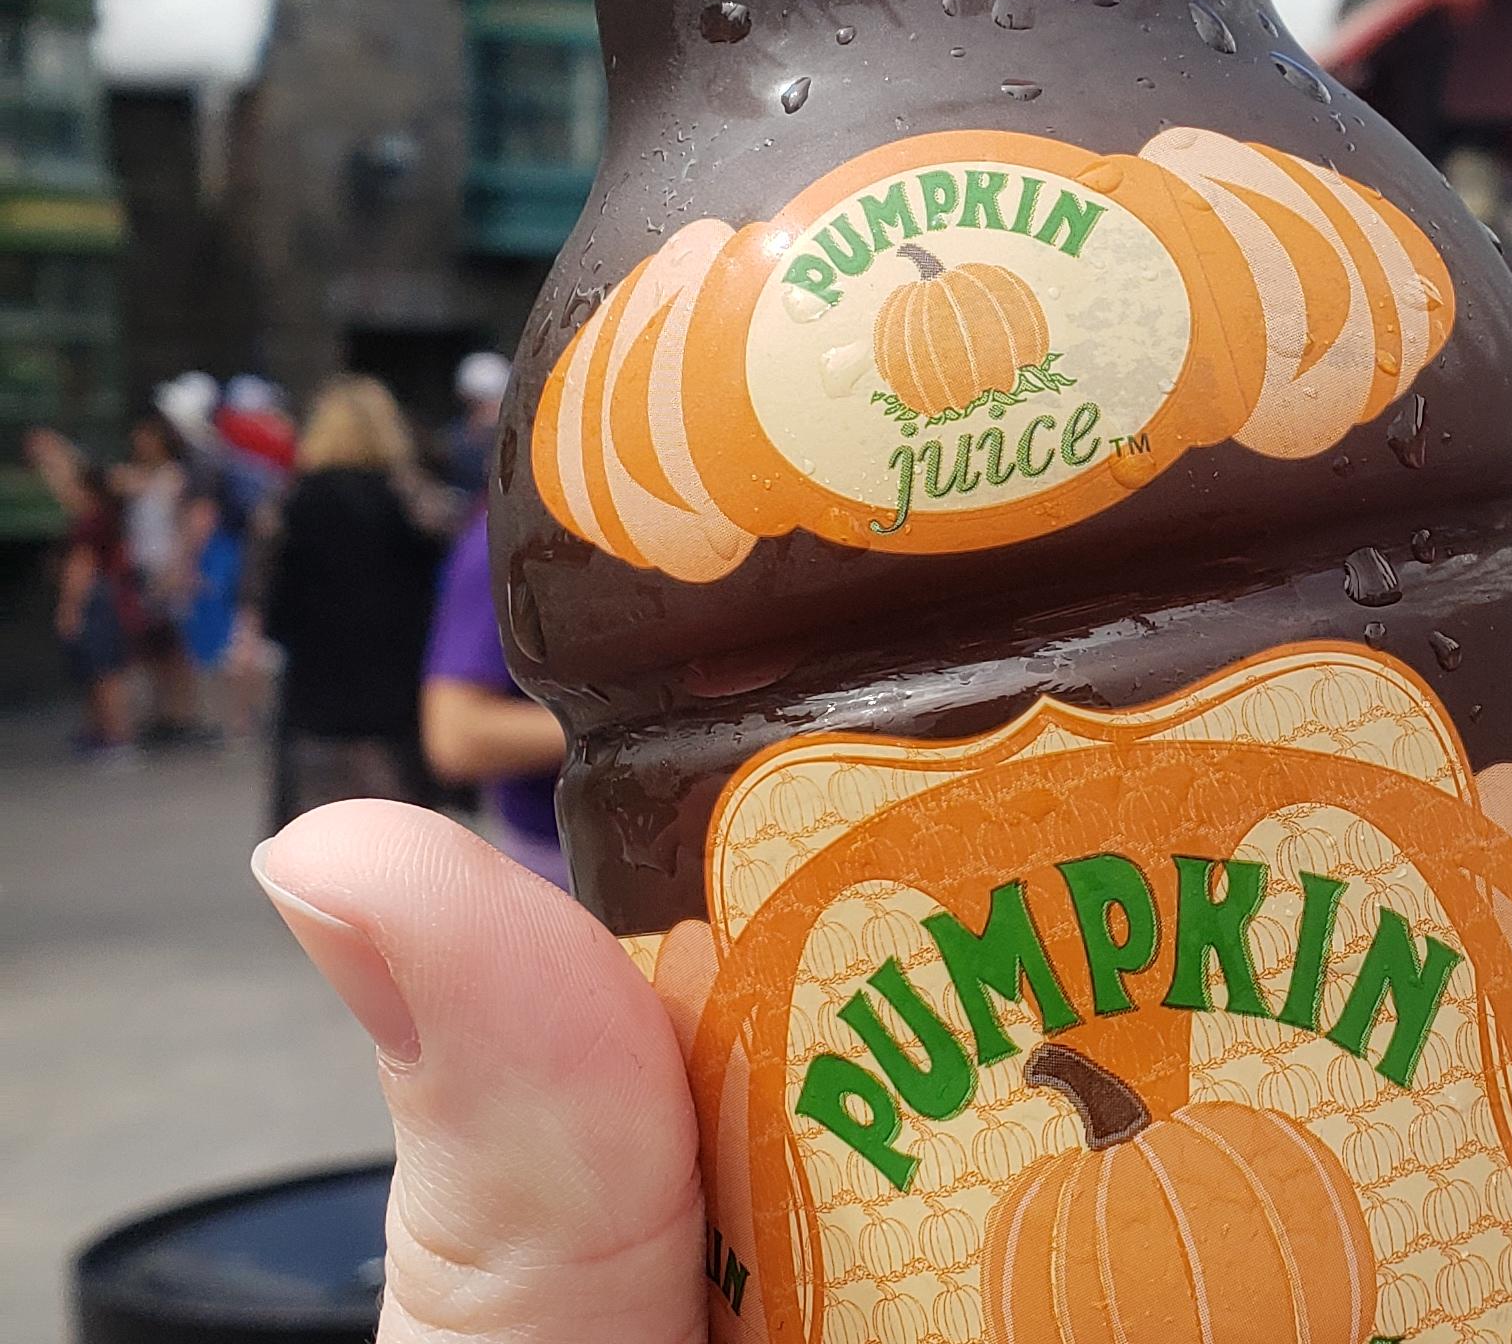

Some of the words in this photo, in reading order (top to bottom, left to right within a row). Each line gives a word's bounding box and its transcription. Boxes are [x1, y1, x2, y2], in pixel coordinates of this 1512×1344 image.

[782, 169, 1108, 305] PUMPKIN
[868, 402, 1102, 535] juice
[797, 852, 1465, 1193] PUMPKIN
